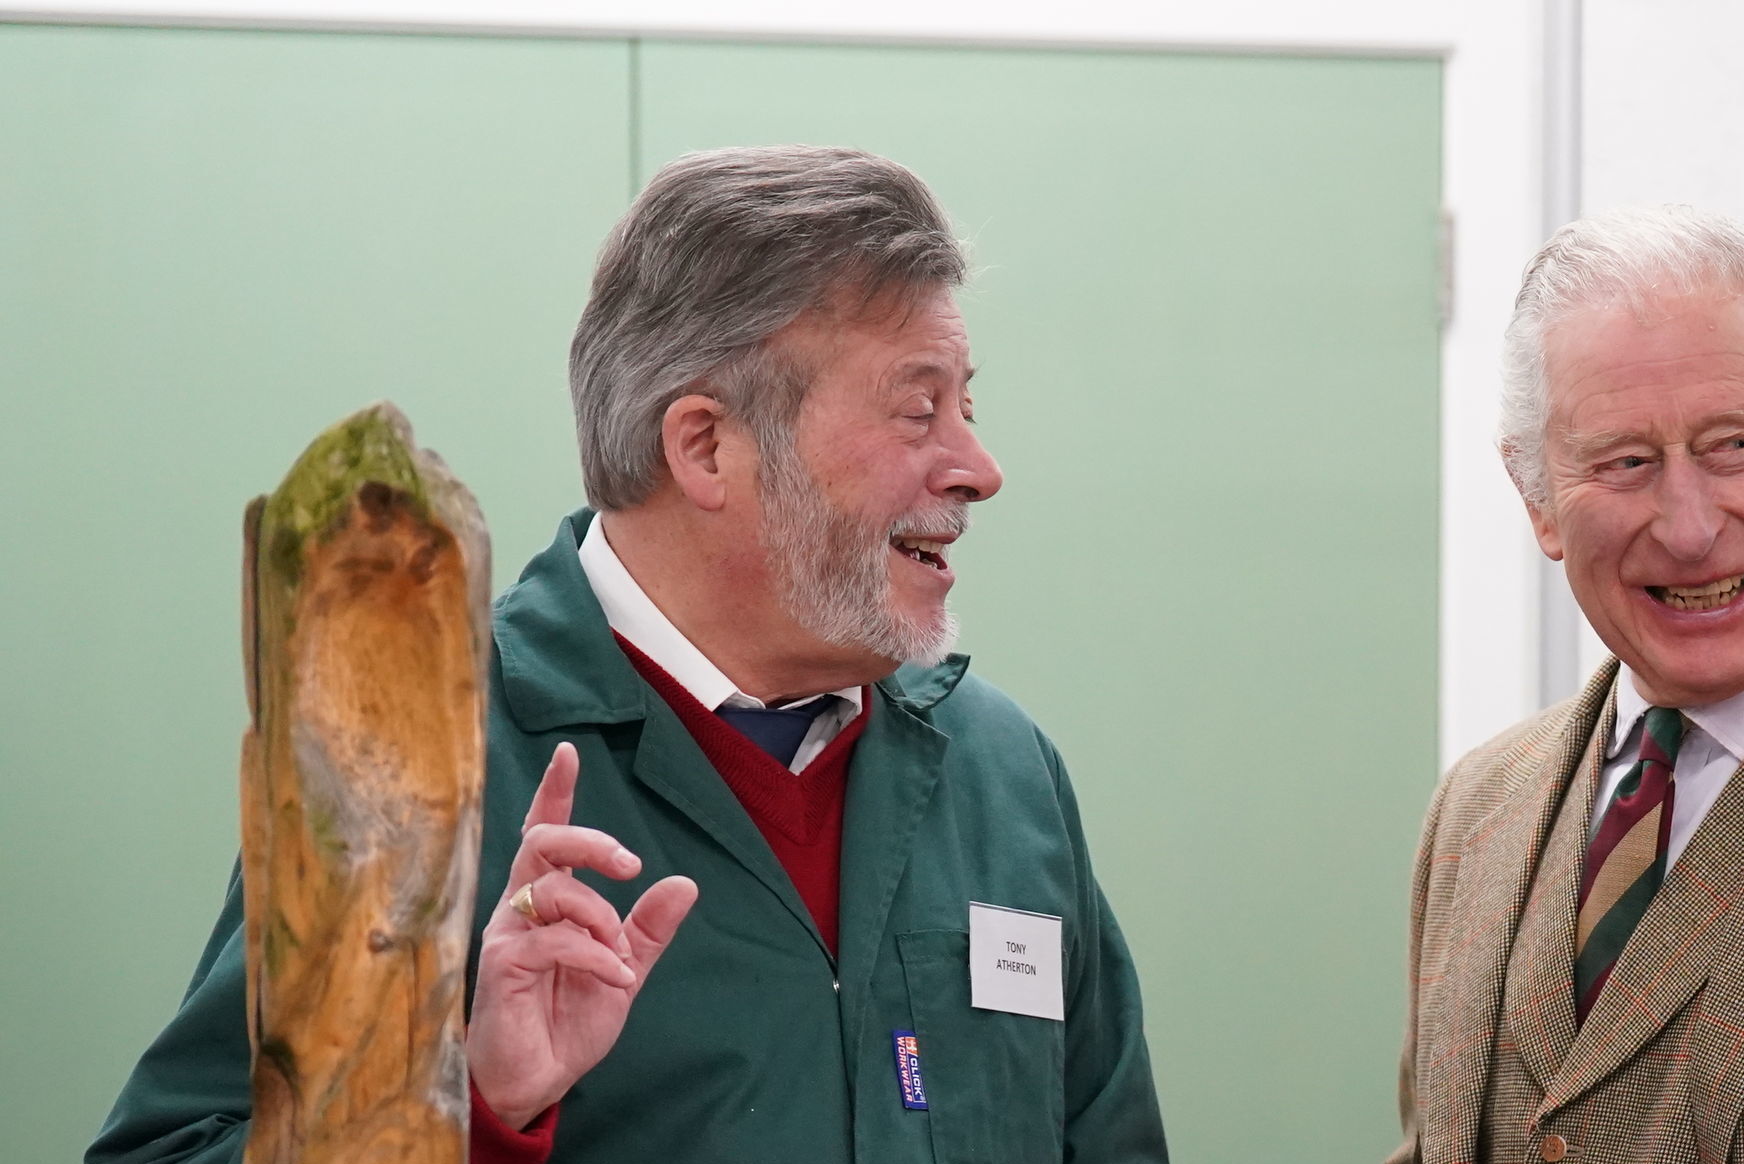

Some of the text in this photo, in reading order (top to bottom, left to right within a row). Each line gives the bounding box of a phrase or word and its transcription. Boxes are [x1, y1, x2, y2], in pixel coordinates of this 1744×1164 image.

[1006, 941, 1027, 955] TONY
[996, 959, 1037, 976] ATHERTON
[896, 1036, 913, 1102] WORKWEAR
[910, 1057, 923, 1096] CLICK
